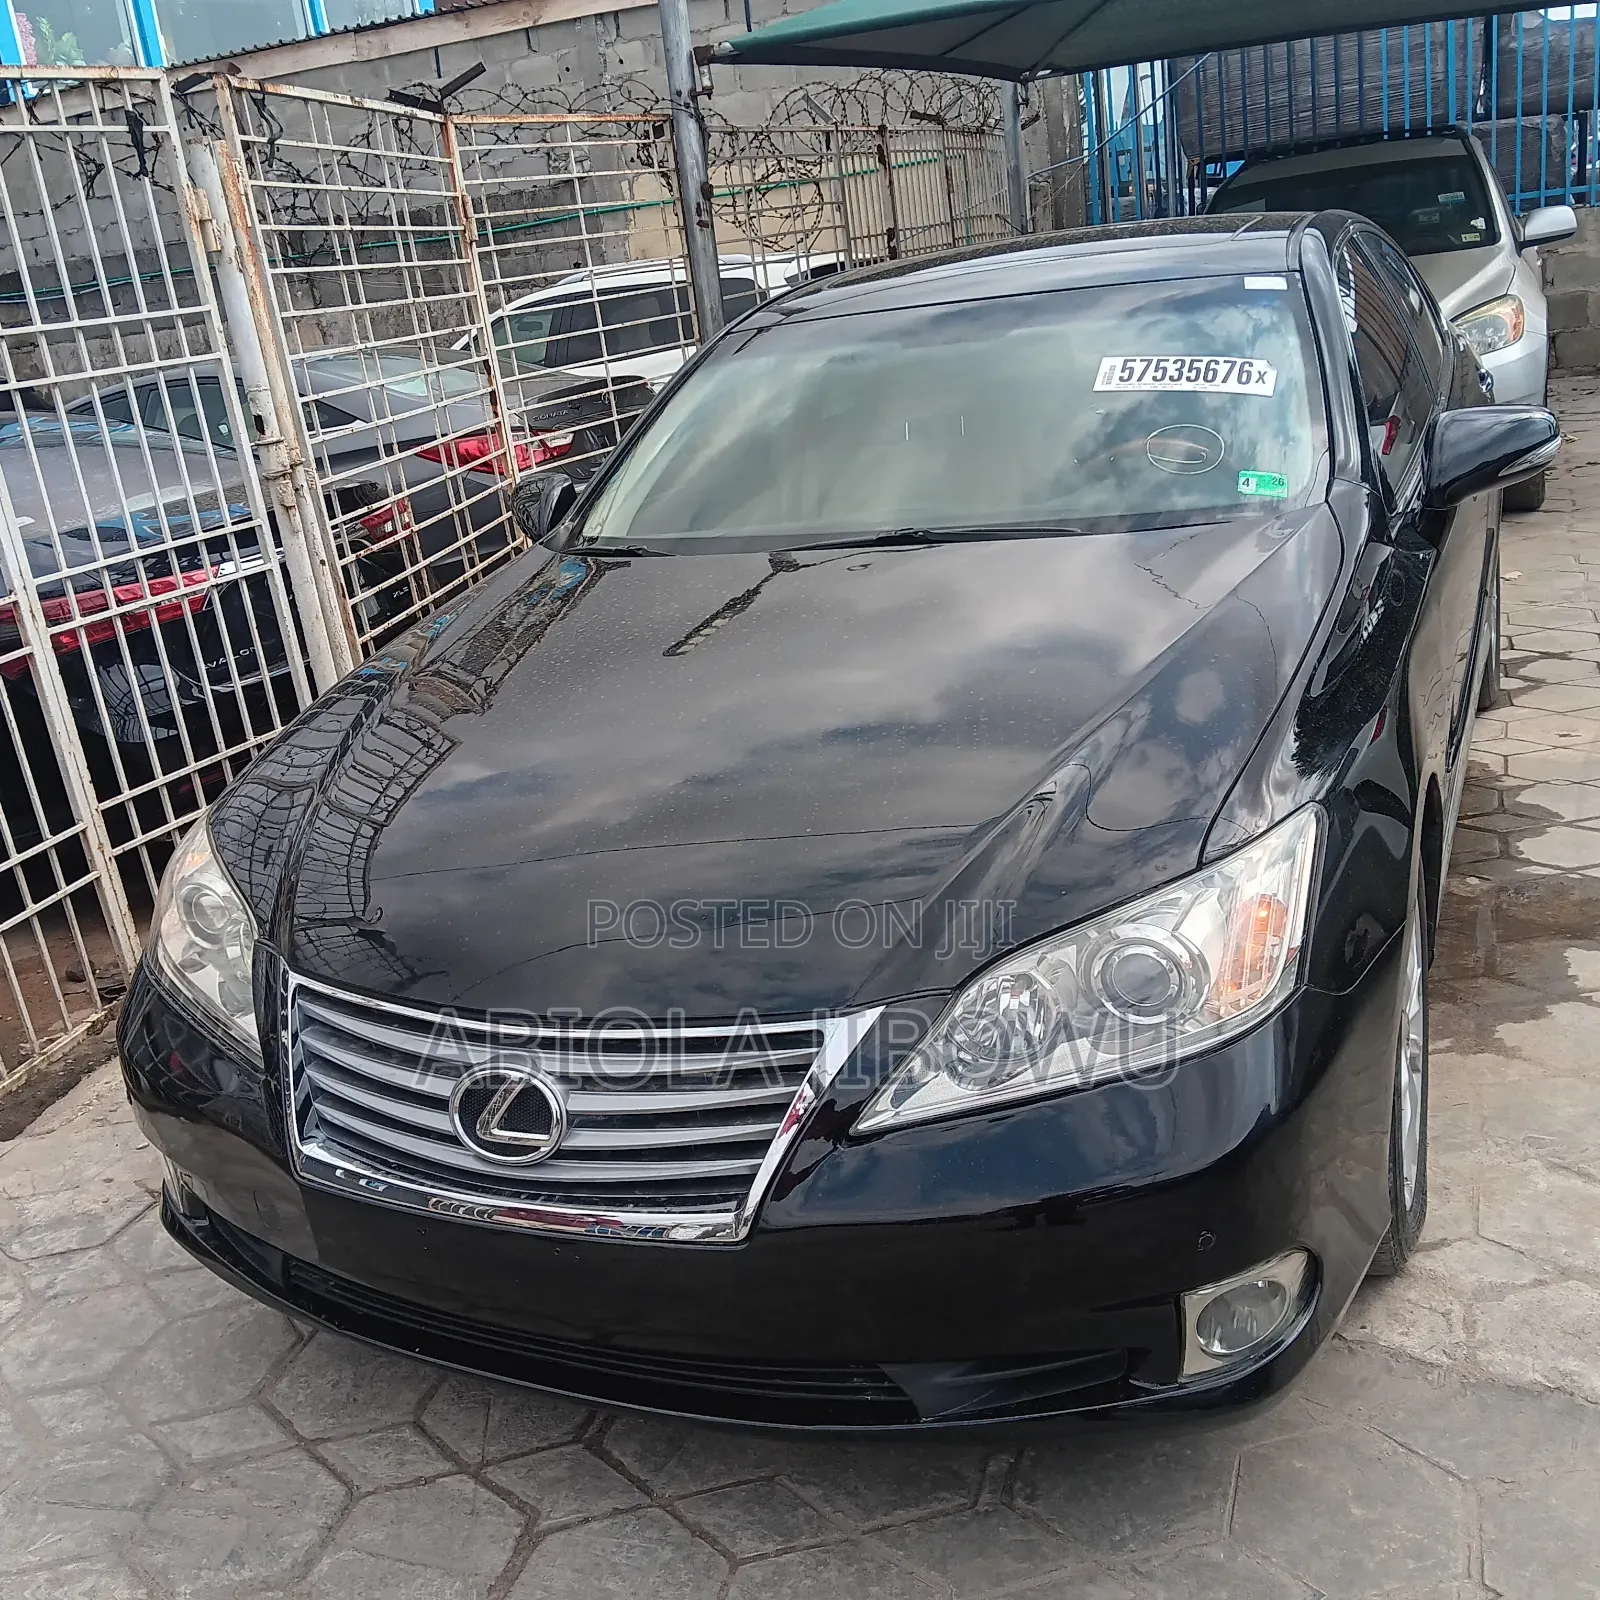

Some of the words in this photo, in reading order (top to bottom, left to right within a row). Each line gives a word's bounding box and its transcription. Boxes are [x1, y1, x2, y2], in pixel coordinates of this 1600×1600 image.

[1242, 477, 1250, 488] 4
[1271, 476, 1285, 487] 26
[203, 646, 257, 670] VAON
